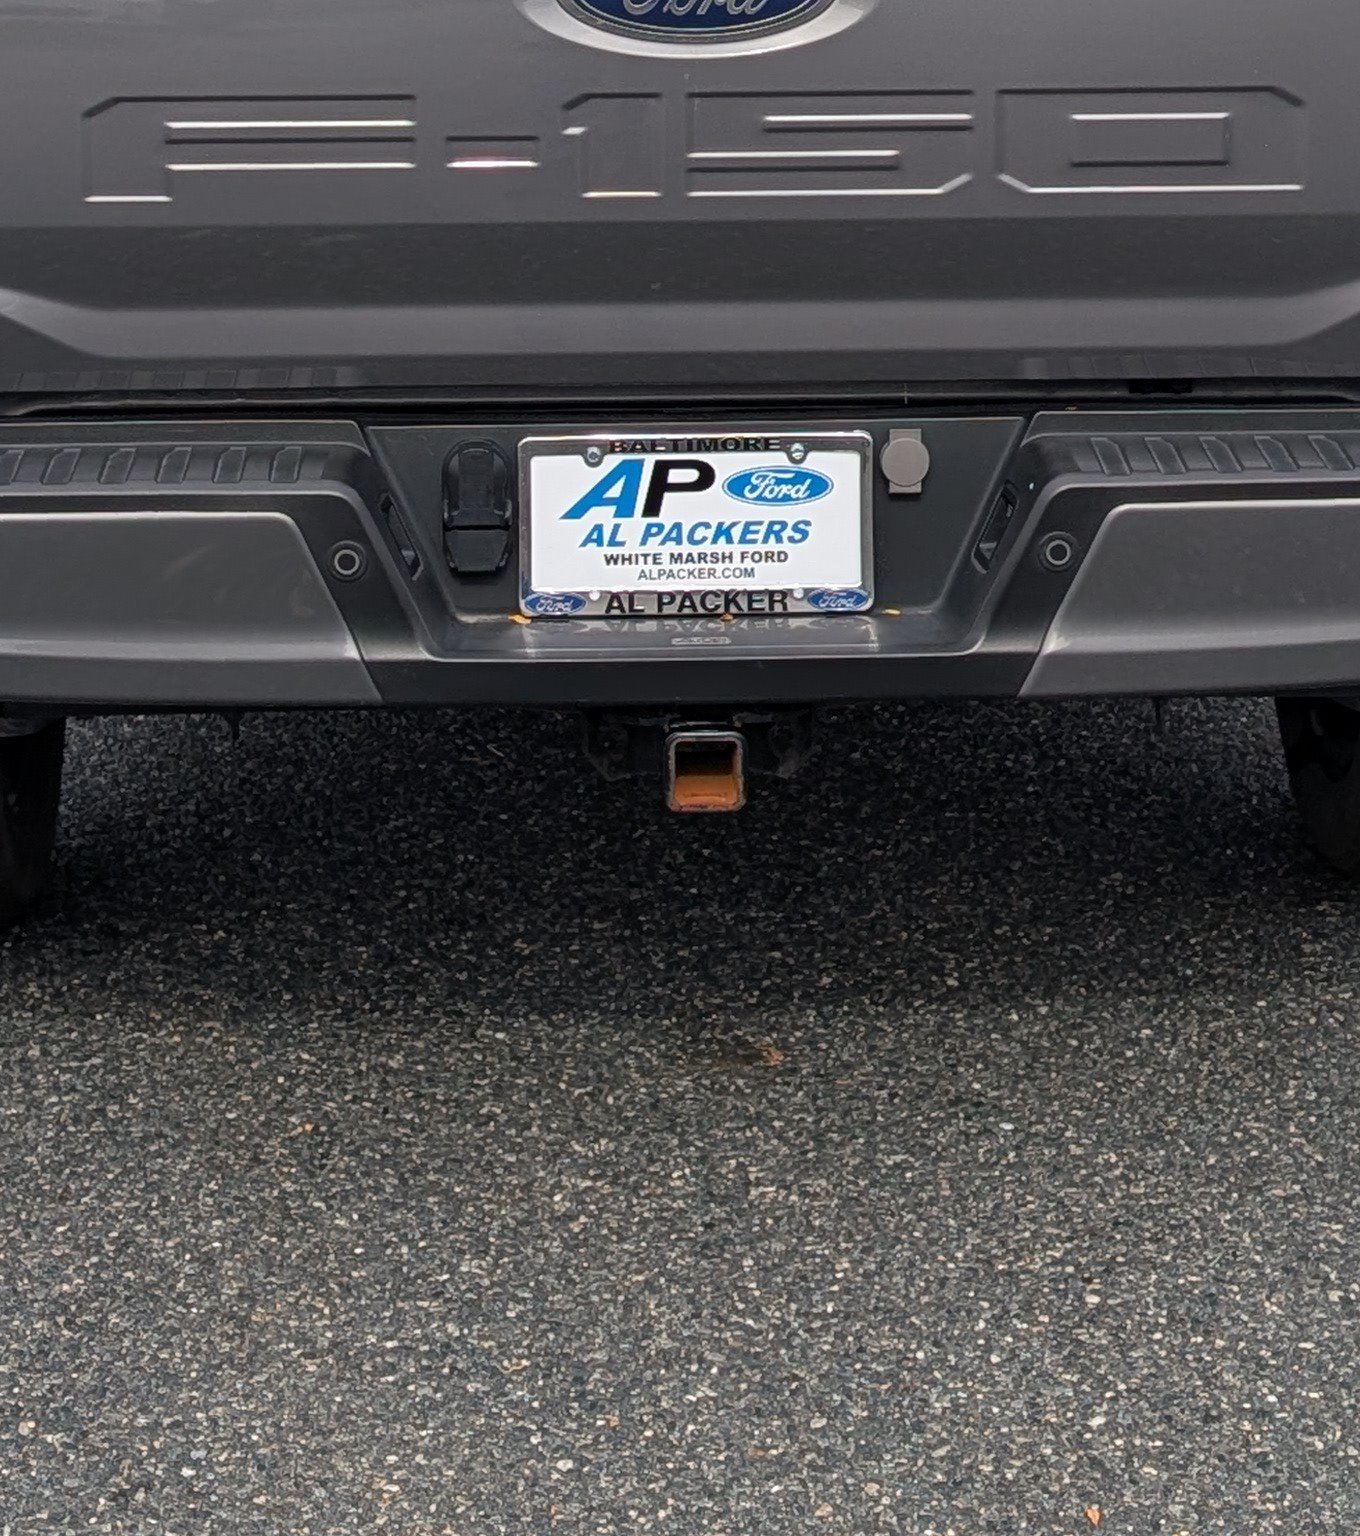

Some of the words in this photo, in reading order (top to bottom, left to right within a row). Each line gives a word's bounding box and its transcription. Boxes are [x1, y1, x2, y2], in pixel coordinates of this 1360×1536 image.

[83, 85, 1304, 204] F-150
[608, 437, 781, 454] BALTIMORE
[559, 457, 717, 520] AP
[743, 471, 812, 500] Ford
[578, 522, 628, 548] AL
[639, 519, 813, 547] PACKERS
[603, 552, 663, 566] WHITE
[668, 551, 733, 565] MARSH
[740, 550, 789, 564] FORD
[636, 567, 756, 581] ALPACKER.COM
[535, 596, 576, 612] Ford
[604, 592, 645, 614] AL
[656, 590, 789, 614] PACKER
[818, 592, 859, 608] Ford
